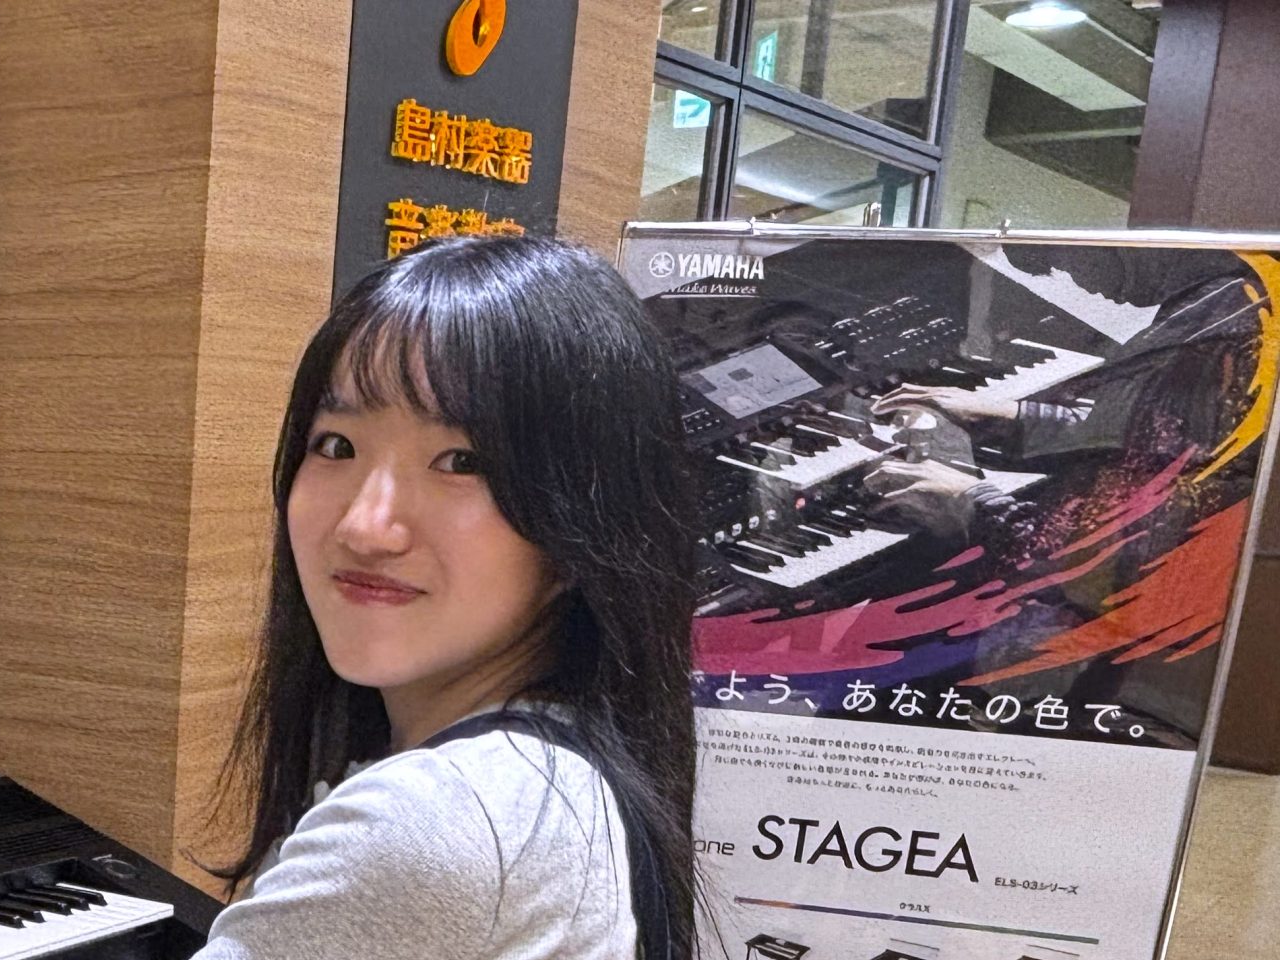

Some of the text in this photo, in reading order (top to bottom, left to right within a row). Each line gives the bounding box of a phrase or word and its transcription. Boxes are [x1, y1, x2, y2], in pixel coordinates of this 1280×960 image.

[391, 98, 533, 184] 島村楽器
[677, 252, 765, 280] YAMAHA
[692, 814, 980, 884] one STAGEA
